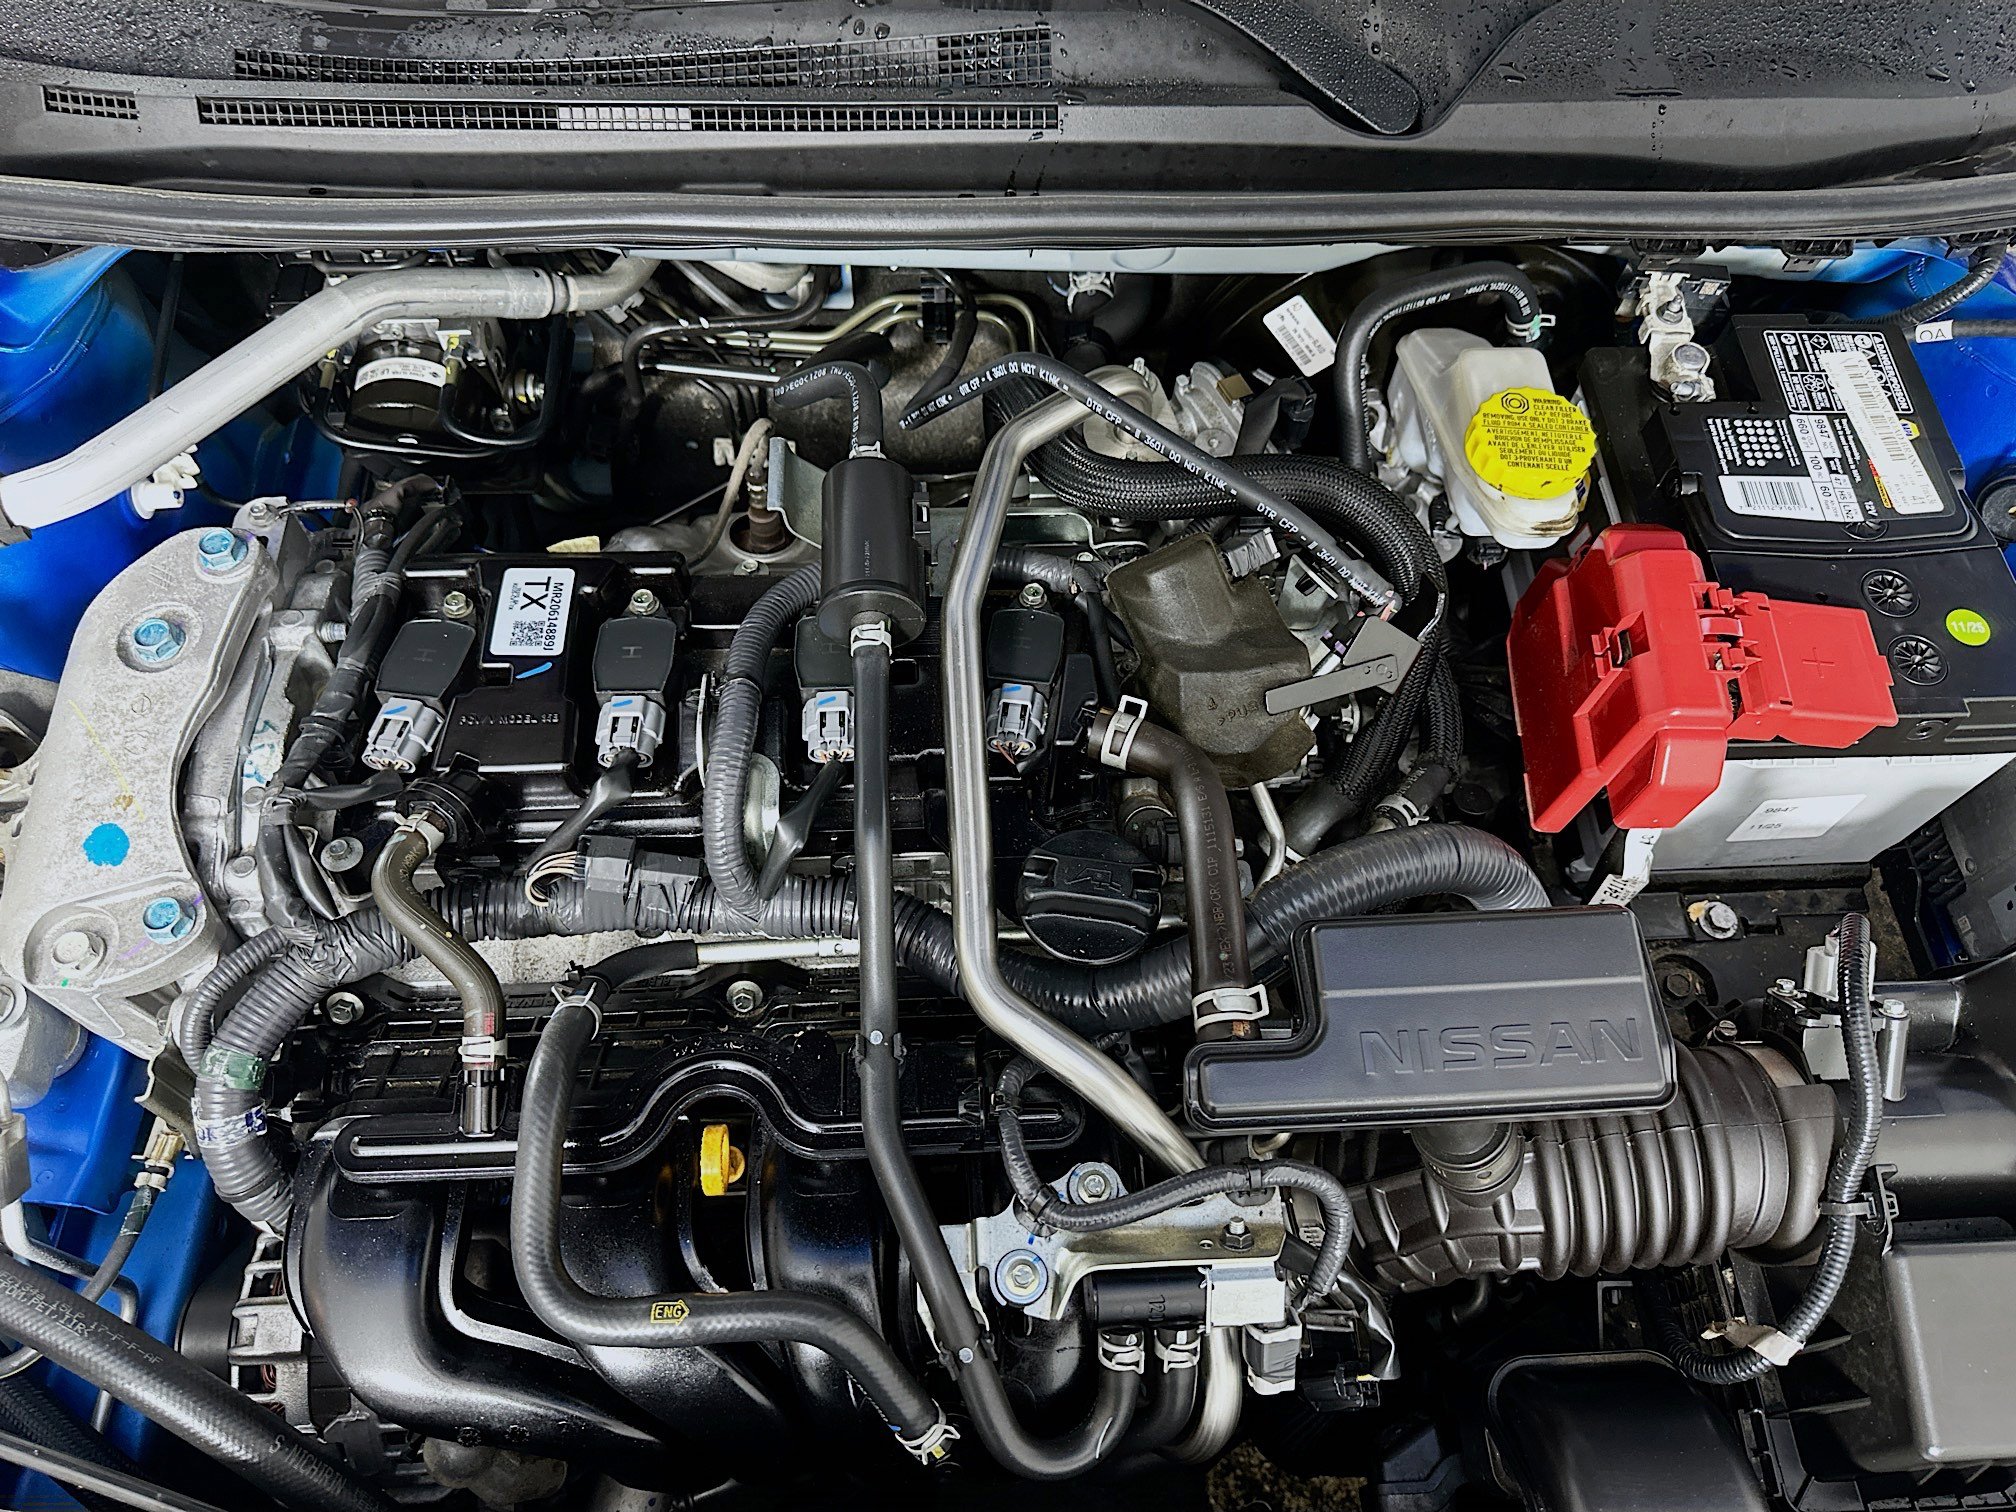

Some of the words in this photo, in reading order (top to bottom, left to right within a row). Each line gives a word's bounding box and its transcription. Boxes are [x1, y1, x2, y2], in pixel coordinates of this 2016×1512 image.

[1039, 367, 1060, 387] KINK
[1794, 418, 1810, 434] 660
[1813, 419, 1830, 438] 9847
[1086, 397, 1102, 414] DTR
[1105, 410, 1122, 425] CFP
[1169, 451, 1182, 464] DO
[1184, 459, 1201, 475] NOT
[1204, 471, 1228, 491] KINK
[1808, 455, 1823, 470] 100
[1833, 476, 1842, 485] 47
[1819, 486, 1832, 497] 60
[1842, 504, 1854, 519] LN2
[1862, 500, 1878, 516] 12V
[1256, 503, 1278, 520] DTR
[1278, 517, 1299, 533] CFP
[520, 576, 552, 610] TX
[542, 582, 564, 650] MR20614889J
[1951, 621, 1986, 634] 11/25
[1765, 806, 1798, 814] 9847
[1207, 858, 1218, 876] CIP
[1210, 883, 1228, 933] >NBR/CR<
[1360, 1018, 1644, 1076] NISSAN
[656, 1306, 682, 1318] ENG
